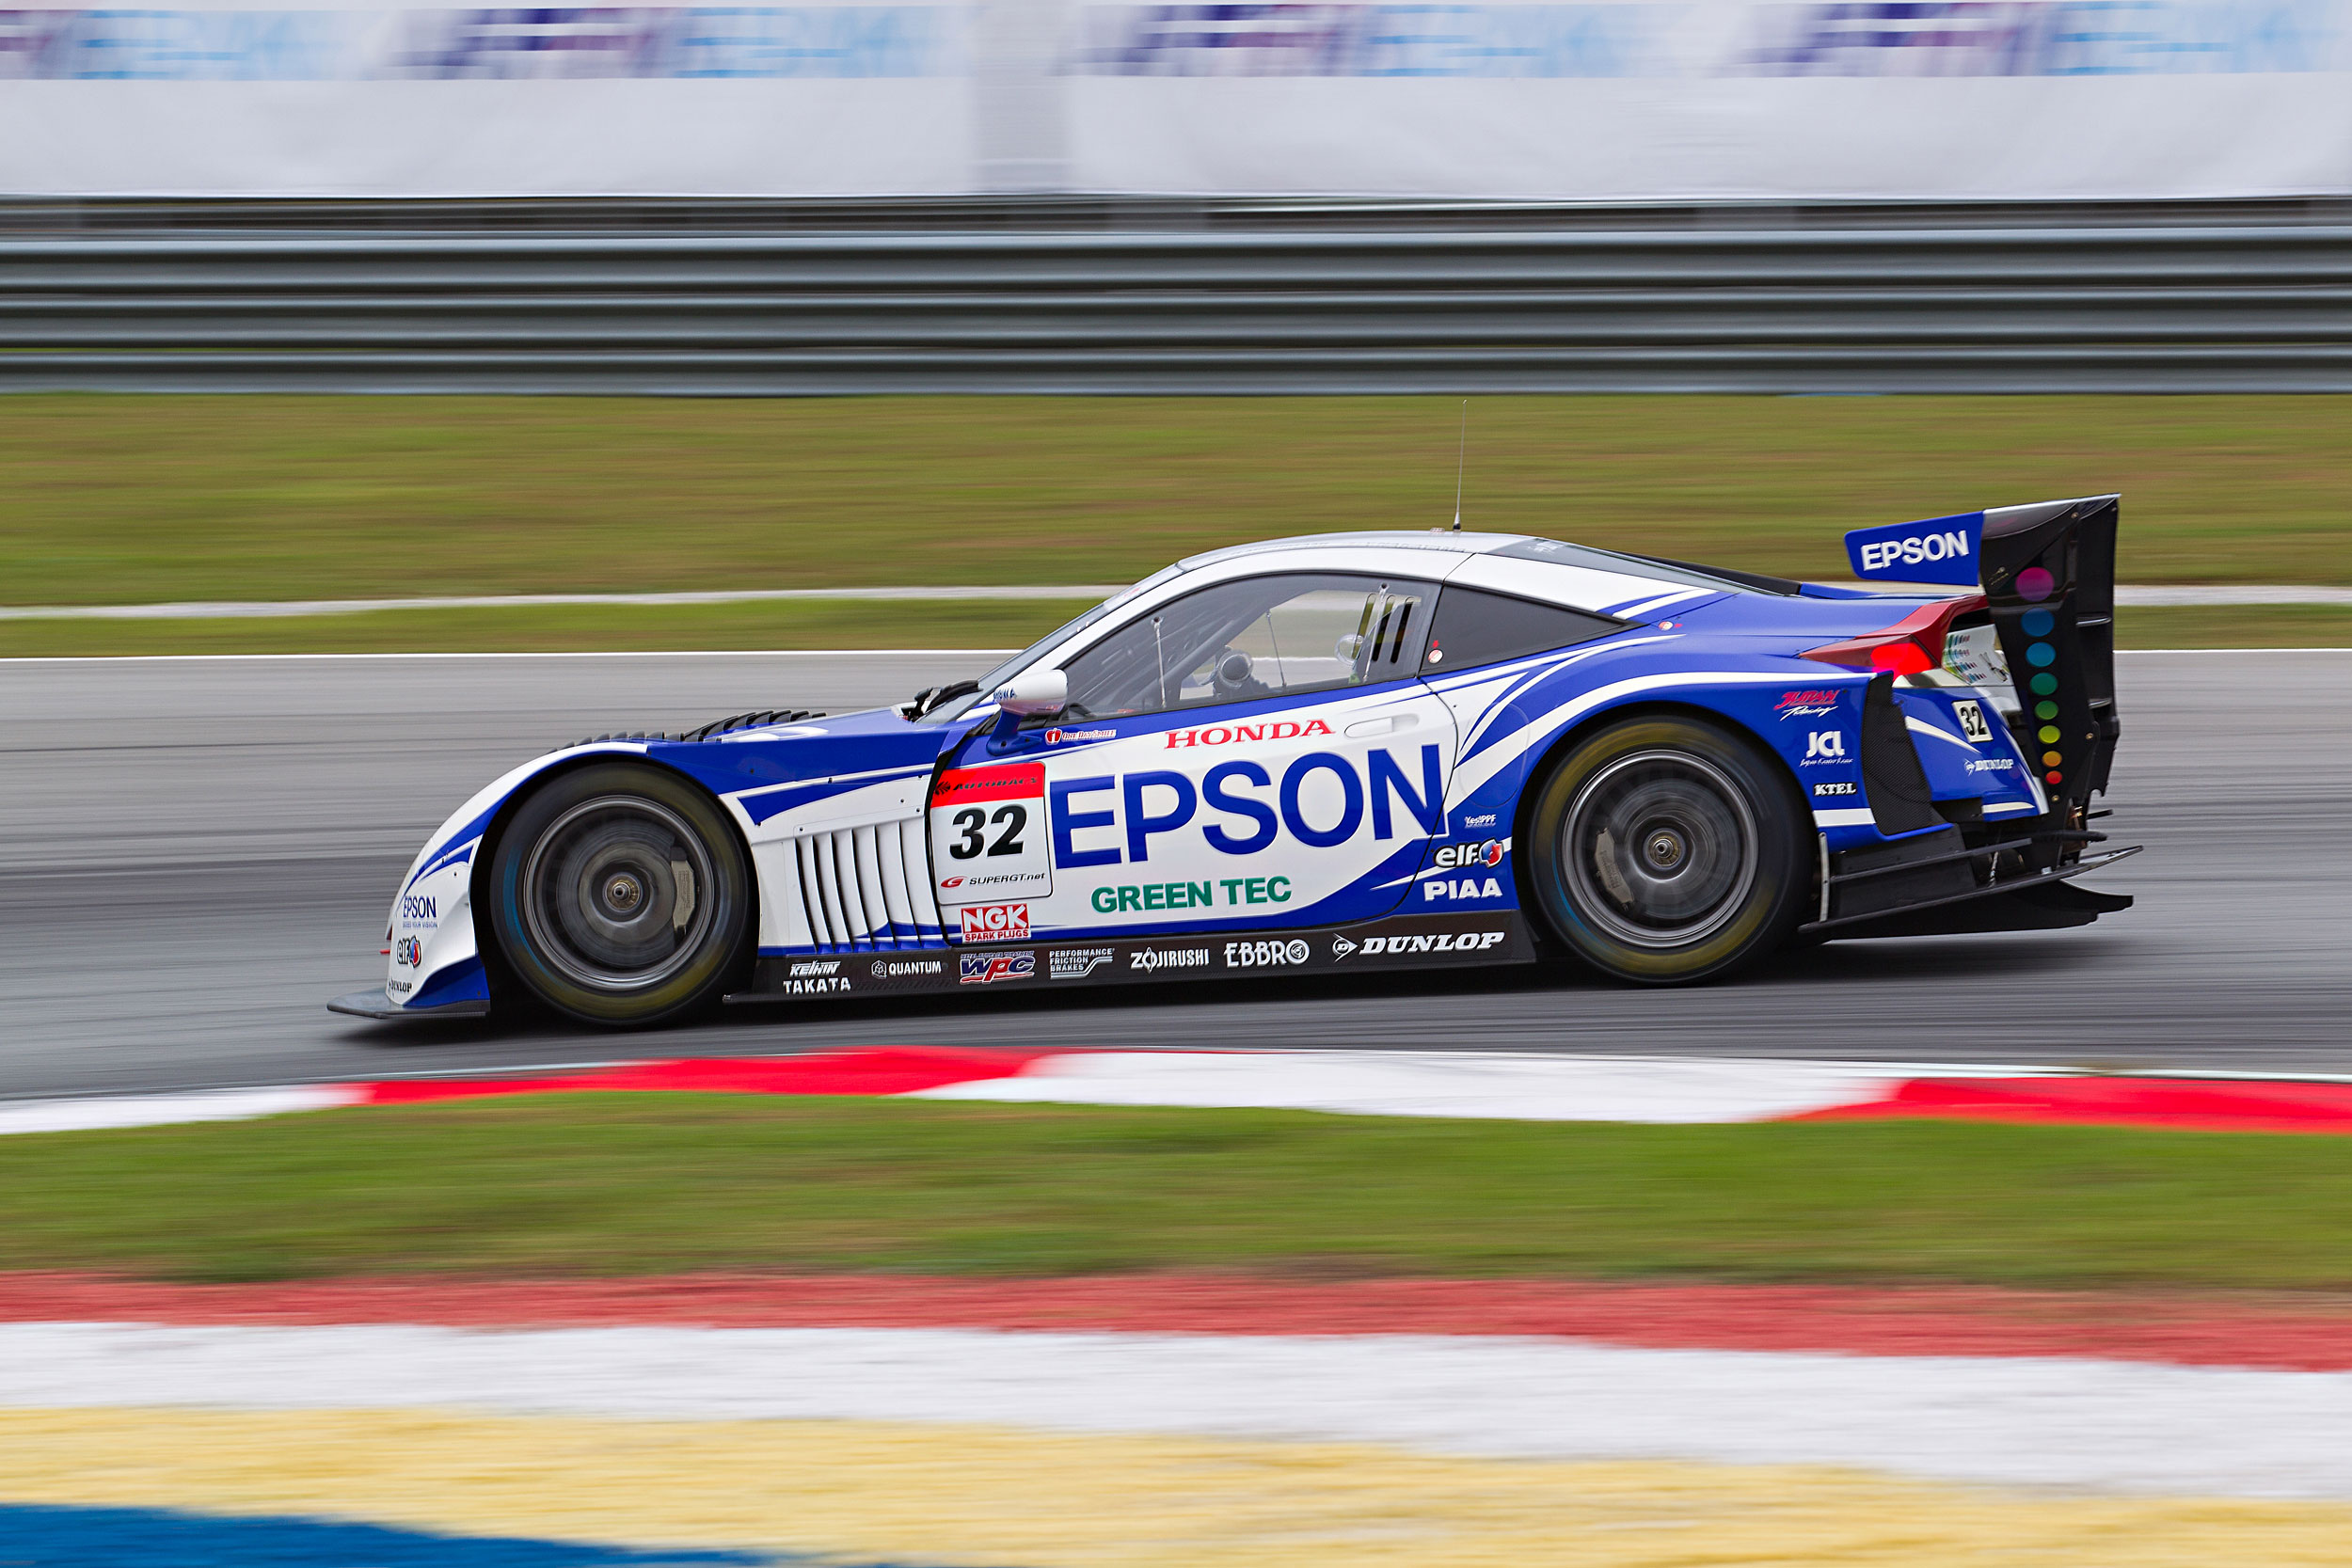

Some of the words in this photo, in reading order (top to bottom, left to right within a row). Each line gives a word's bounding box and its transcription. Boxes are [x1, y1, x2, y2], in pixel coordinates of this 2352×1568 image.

[1861, 531, 1969, 571] EPSON
[1960, 706, 1987, 736] 32
[1164, 720, 1335, 749] HONDA
[1806, 731, 1845, 757] JCL
[953, 777, 1038, 790] AUTOBACS
[1814, 784, 1856, 796] KTEL
[1049, 744, 1447, 869] EPSON
[949, 804, 1027, 860] 32
[1435, 844, 1480, 867] elf
[969, 873, 1045, 885] SUPERGT.net
[1424, 879, 1502, 901] PIAA
[1091, 880, 1213, 912] GREEN
[1220, 876, 1292, 904] TEC
[403, 895, 437, 918] EPSON
[963, 904, 1027, 932] NGK
[965, 932, 995, 942] SPARK
[997, 929, 1029, 940] PLUGS
[1359, 932, 1505, 955] DUNLOP
[1049, 948, 1112, 958] PERFORMANCE
[1050, 957, 1089, 965] FRICTION
[1130, 947, 1210, 974] ZOJIRUSHI
[1224, 939, 1310, 968] EBBRO
[789, 960, 841, 977] KEIHIN
[888, 960, 942, 975] QUANTUM
[1050, 963, 1084, 972] BRAKES
[783, 977, 851, 994] TAKATA
